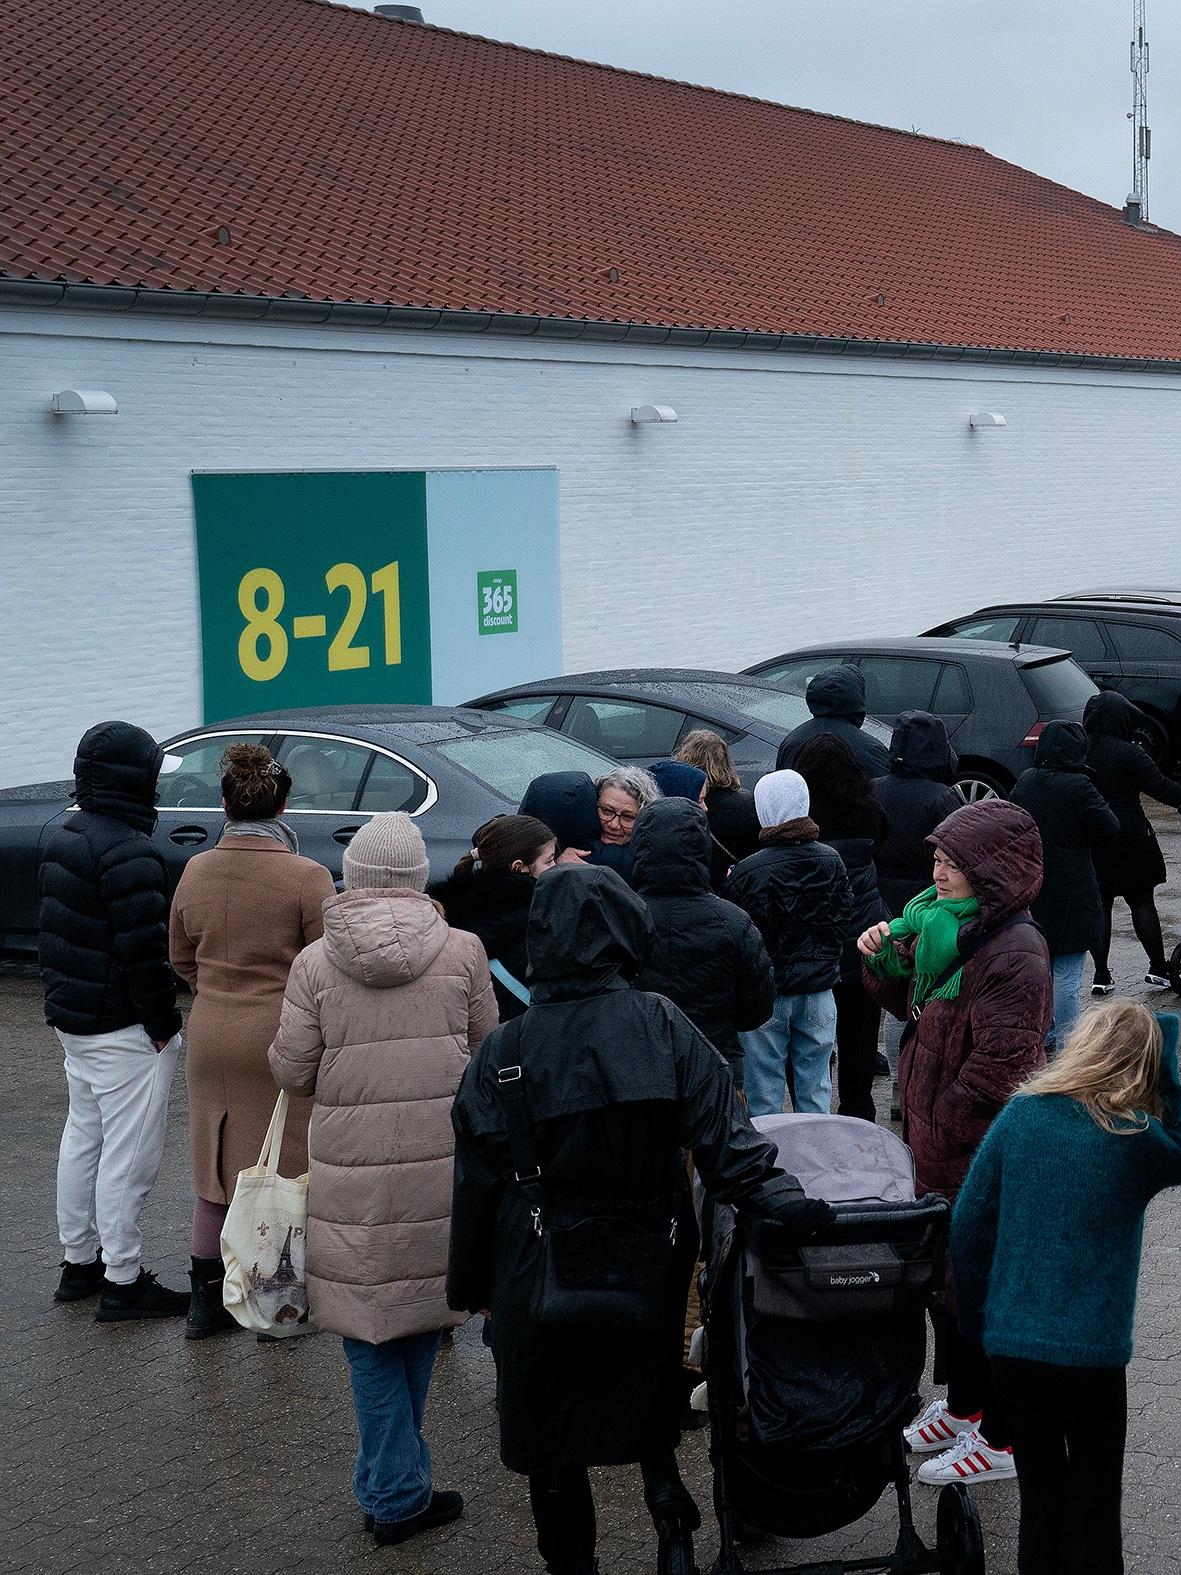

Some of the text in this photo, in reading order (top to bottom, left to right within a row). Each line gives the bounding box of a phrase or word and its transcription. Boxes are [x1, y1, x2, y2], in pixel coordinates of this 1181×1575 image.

[483, 585, 513, 615] 365
[237, 560, 402, 682] 8-21
[483, 614, 513, 627] discount
[830, 1275, 872, 1286] baby jogger
